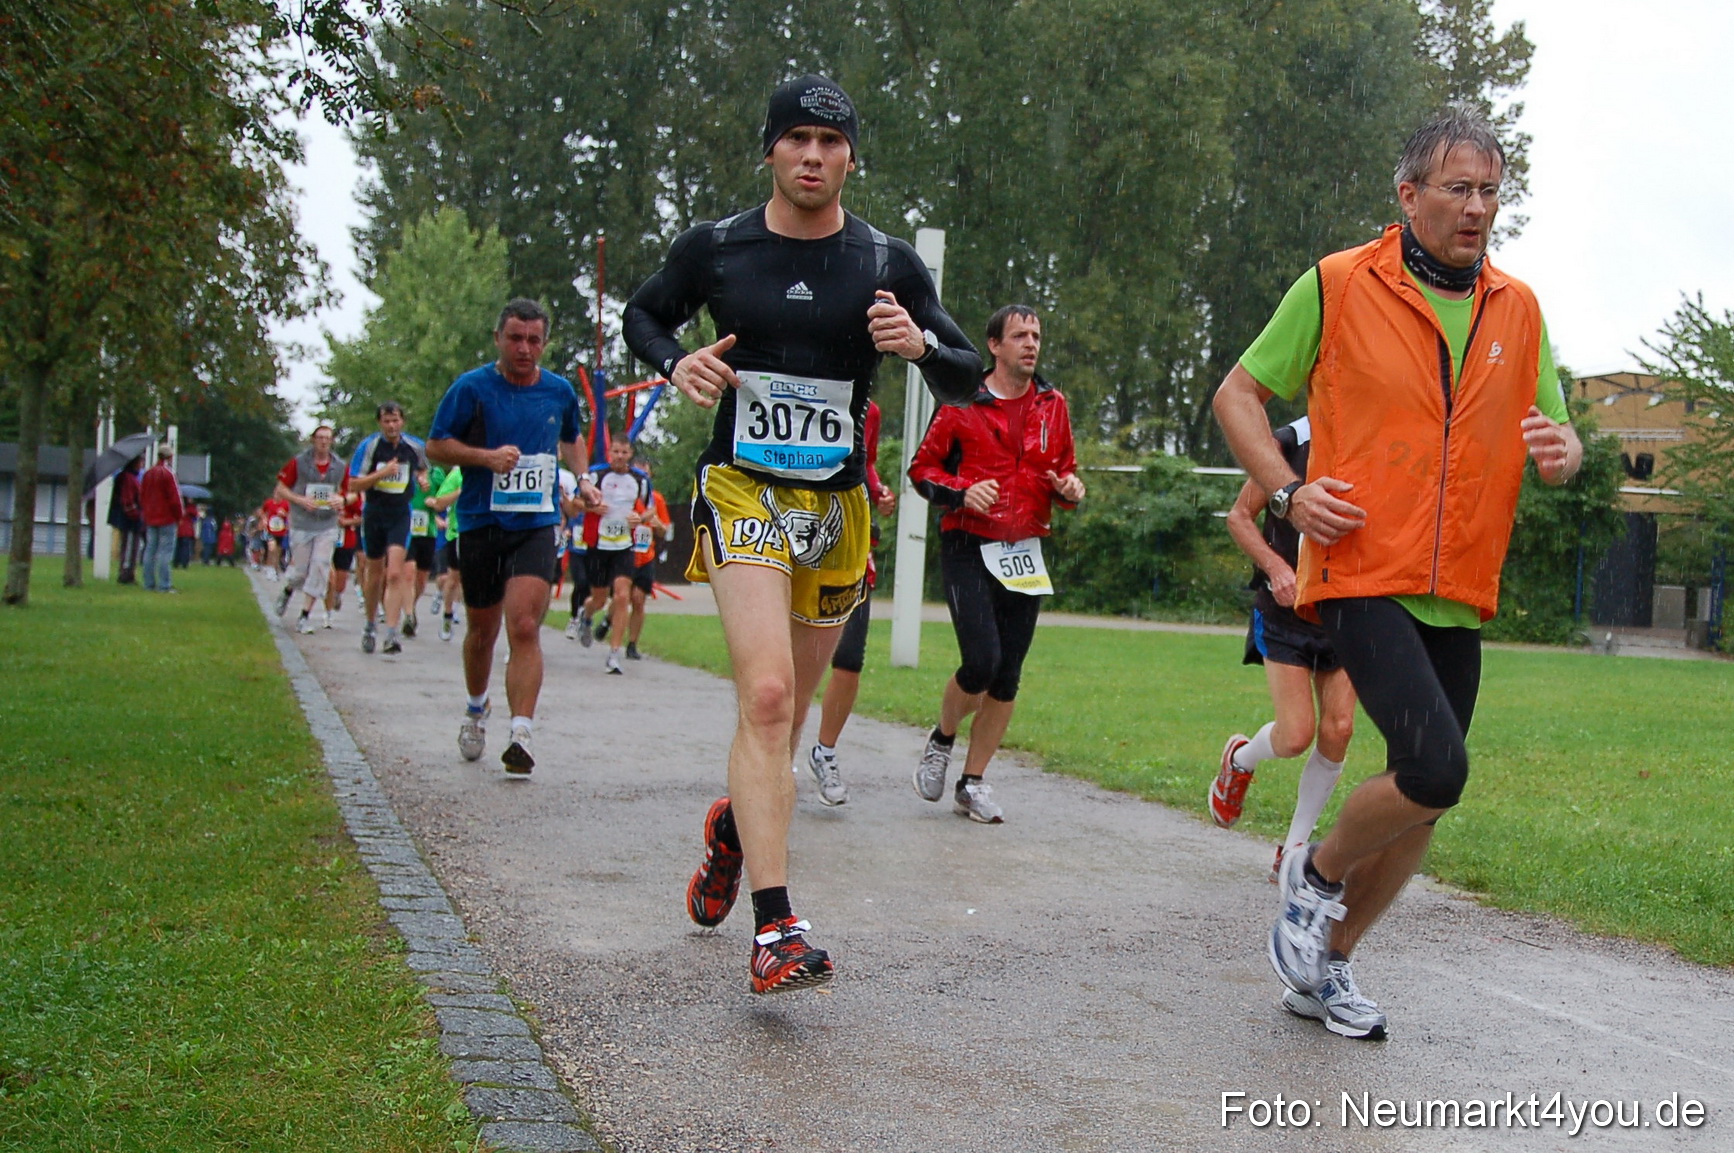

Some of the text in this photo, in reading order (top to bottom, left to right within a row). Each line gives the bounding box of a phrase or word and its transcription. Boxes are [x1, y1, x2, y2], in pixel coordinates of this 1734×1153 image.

[770, 381, 818, 396] BOCK
[748, 400, 842, 443] 3076
[763, 450, 824, 469] Stephan
[999, 554, 1036, 578] 509
[1318, 981, 1338, 1001] N
